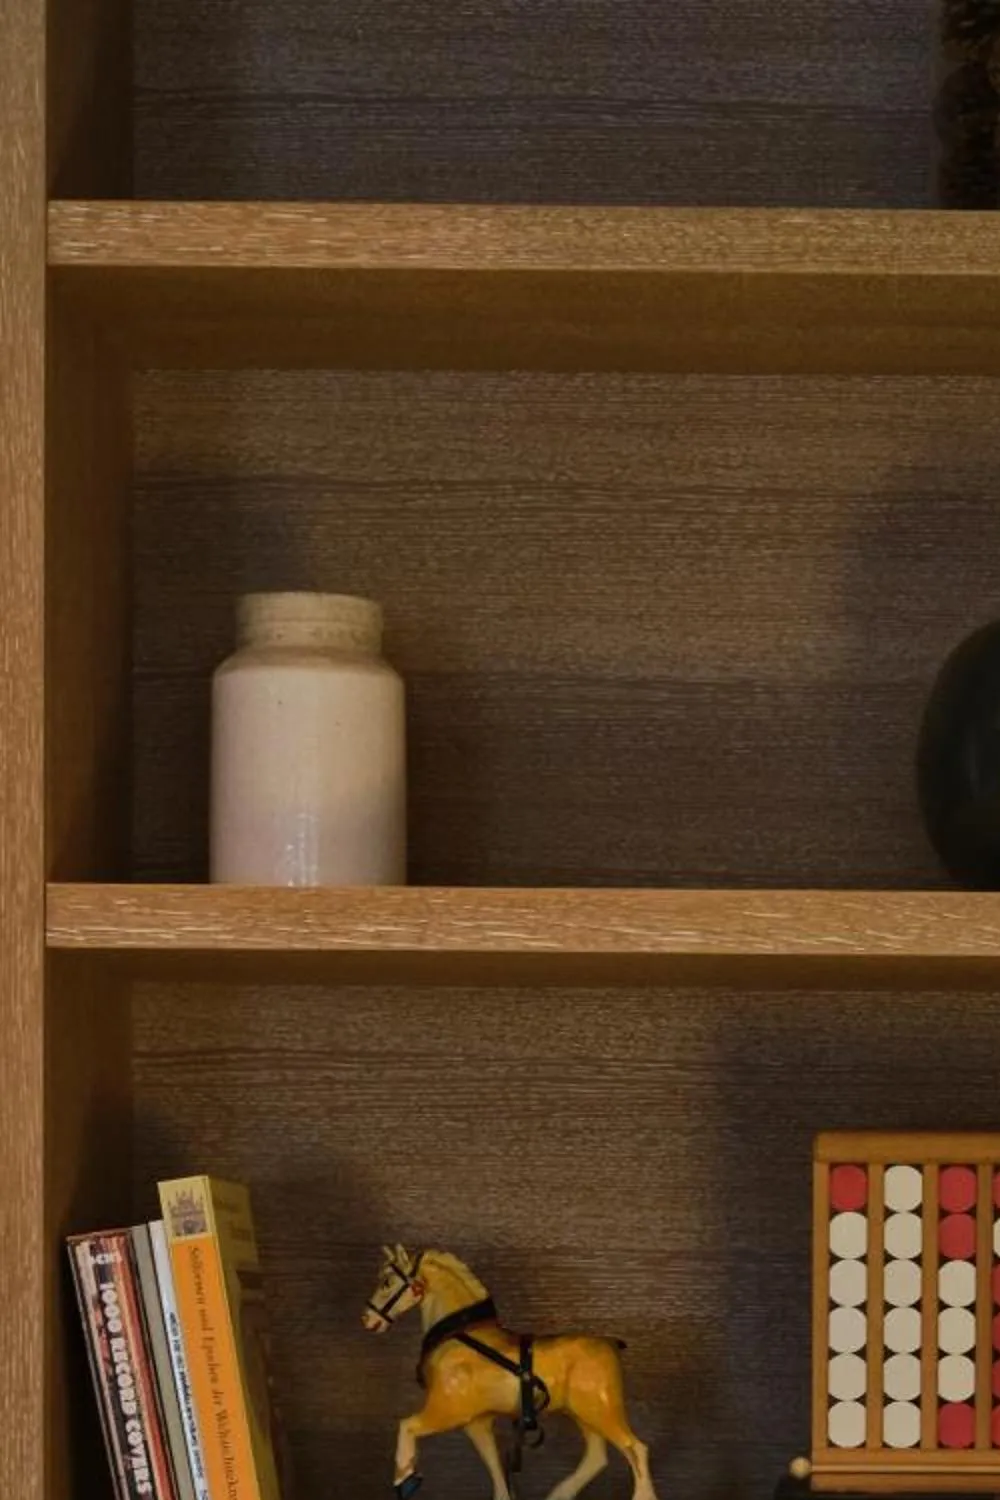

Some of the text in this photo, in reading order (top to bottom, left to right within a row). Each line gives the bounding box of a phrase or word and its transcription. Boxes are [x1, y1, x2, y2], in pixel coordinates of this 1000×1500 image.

[99, 1281, 121, 1333] 1000
[108, 1336, 138, 1416] RECORD
[124, 1418, 152, 1495] COVERS
